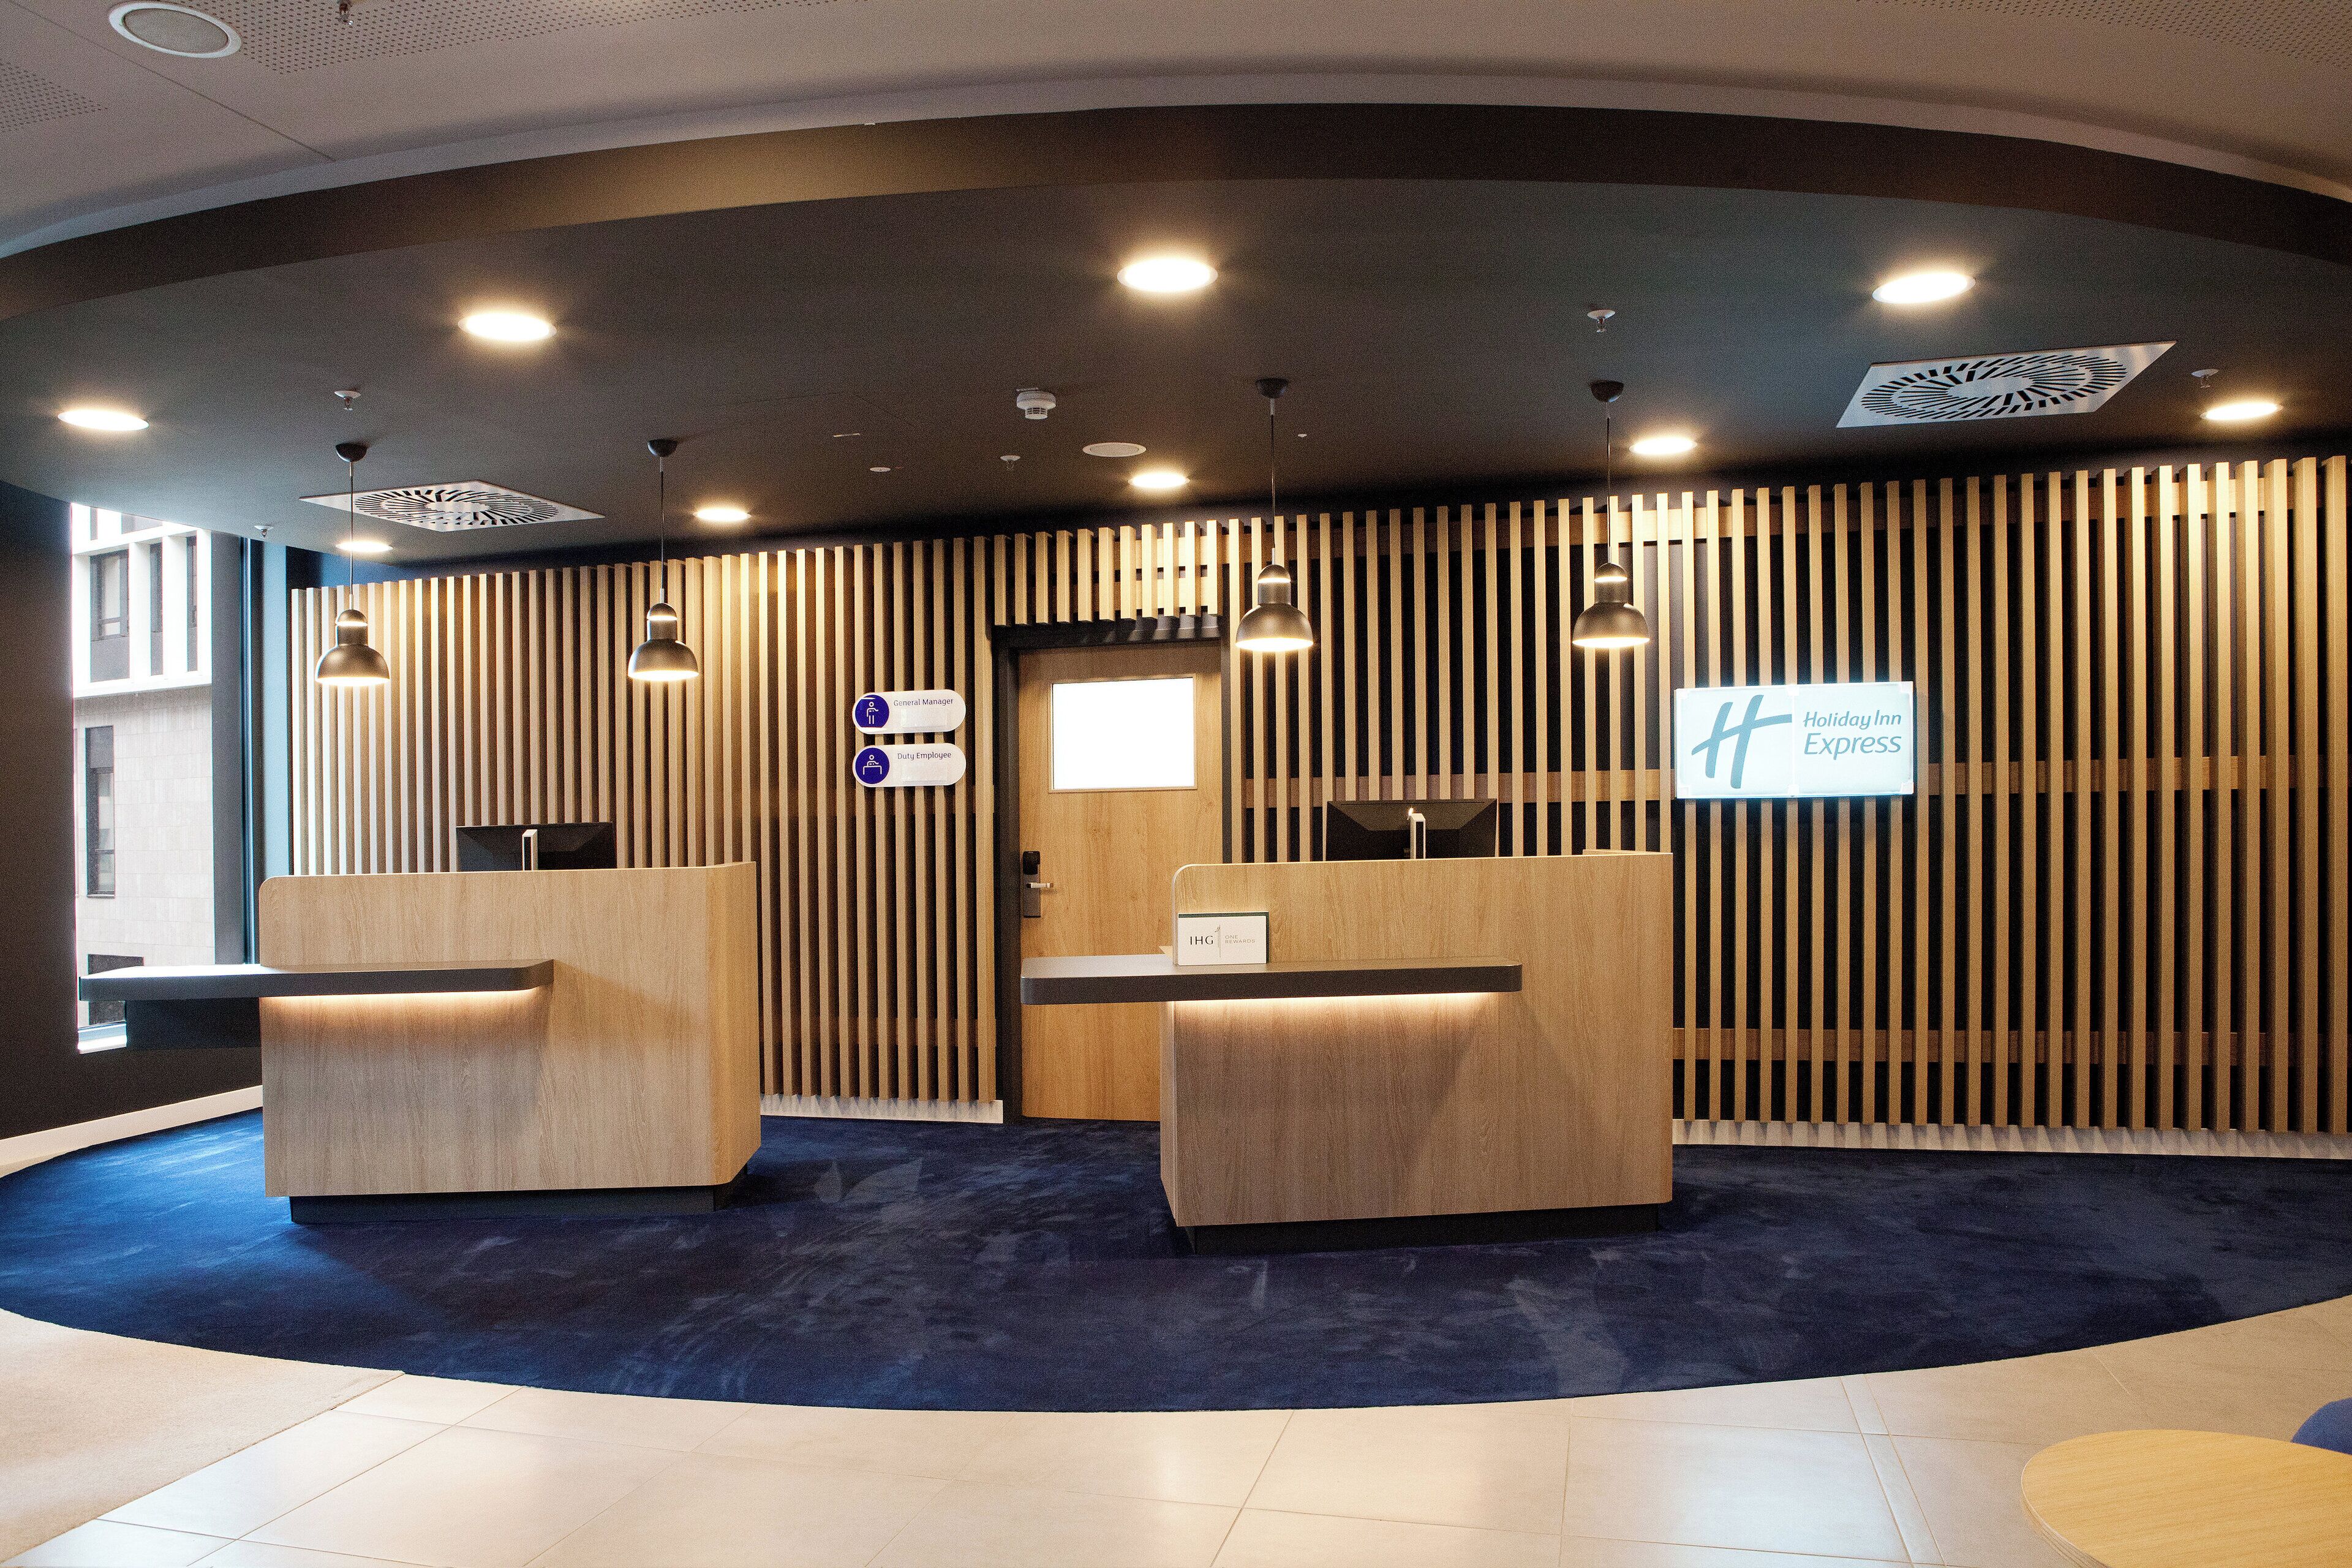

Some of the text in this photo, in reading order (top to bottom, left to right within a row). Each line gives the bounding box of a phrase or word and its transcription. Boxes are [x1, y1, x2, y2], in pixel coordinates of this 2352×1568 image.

[1803, 709, 1902, 730] Holiday Inn
[1804, 733, 1902, 761] Express
[1190, 935, 1213, 945] IHG
